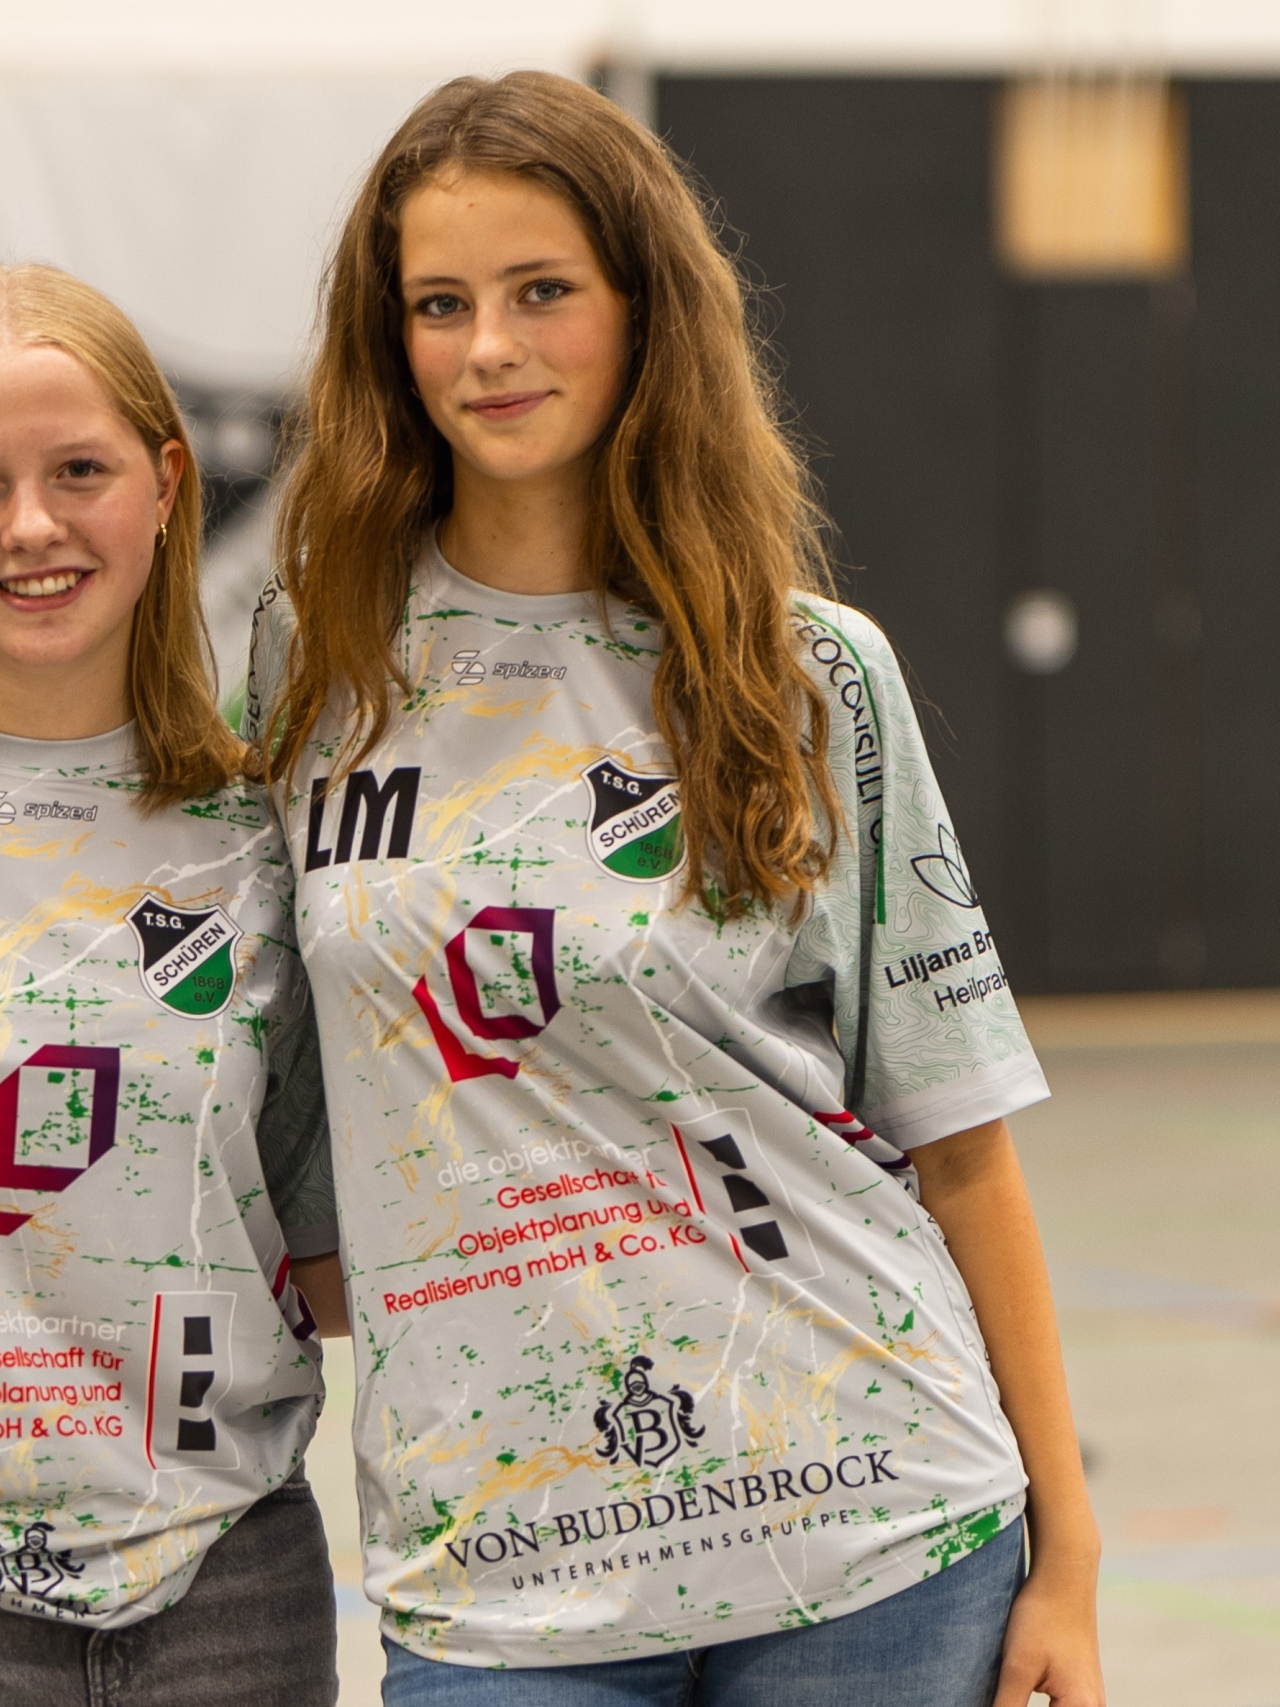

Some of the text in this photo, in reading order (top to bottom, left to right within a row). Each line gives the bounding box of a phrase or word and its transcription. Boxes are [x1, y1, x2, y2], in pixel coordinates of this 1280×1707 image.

[492, 660, 567, 680] spized
[600, 770, 643, 797] T.S.G.
[23, 800, 98, 823] spized
[305, 767, 422, 874] LM
[142, 912, 186, 931] T.S.G.
[153, 922, 227, 987] SCHÜREN
[884, 941, 973, 989] Liljana
[191, 975, 225, 991] 1868
[437, 1161, 480, 1189] die
[458, 1199, 642, 1257] Objektplanung
[383, 1224, 707, 1315] Realisierung mbH & Co. KG
[92, 1347, 124, 1371] für
[81, 1381, 122, 1403] und
[30, 1417, 50, 1438] &
[56, 1415, 93, 1436] Co.
[97, 1415, 123, 1437] KG
[444, 1449, 900, 1571] VON BUDDENBROCK
[511, 1509, 851, 1591] UNTERNEHMENSGRUPPE
